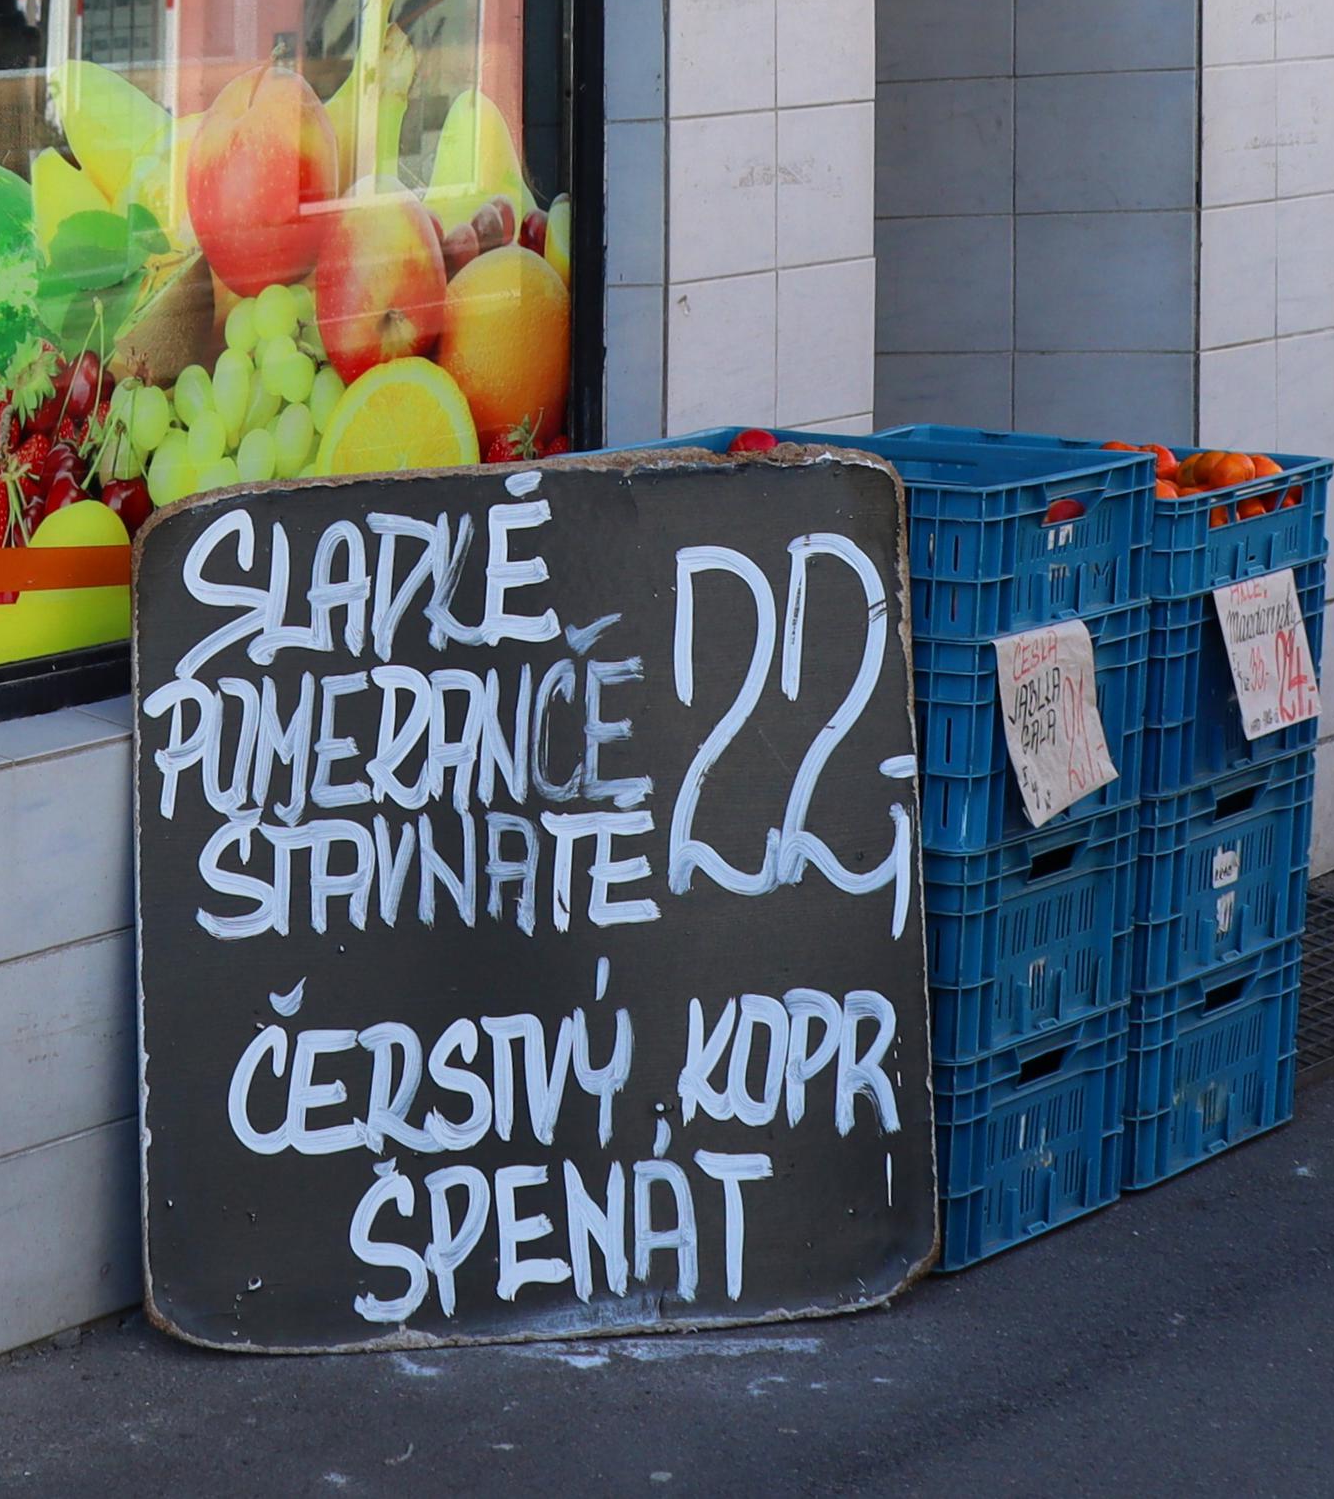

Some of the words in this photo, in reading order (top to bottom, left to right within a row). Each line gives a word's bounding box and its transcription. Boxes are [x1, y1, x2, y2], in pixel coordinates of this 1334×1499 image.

[174, 471, 561, 680] SLADKÉ
[228, 956, 634, 1155] ČERSTVÝ
[678, 987, 903, 1138] KOPR
[349, 1118, 774, 1324] ŠPENÁT
